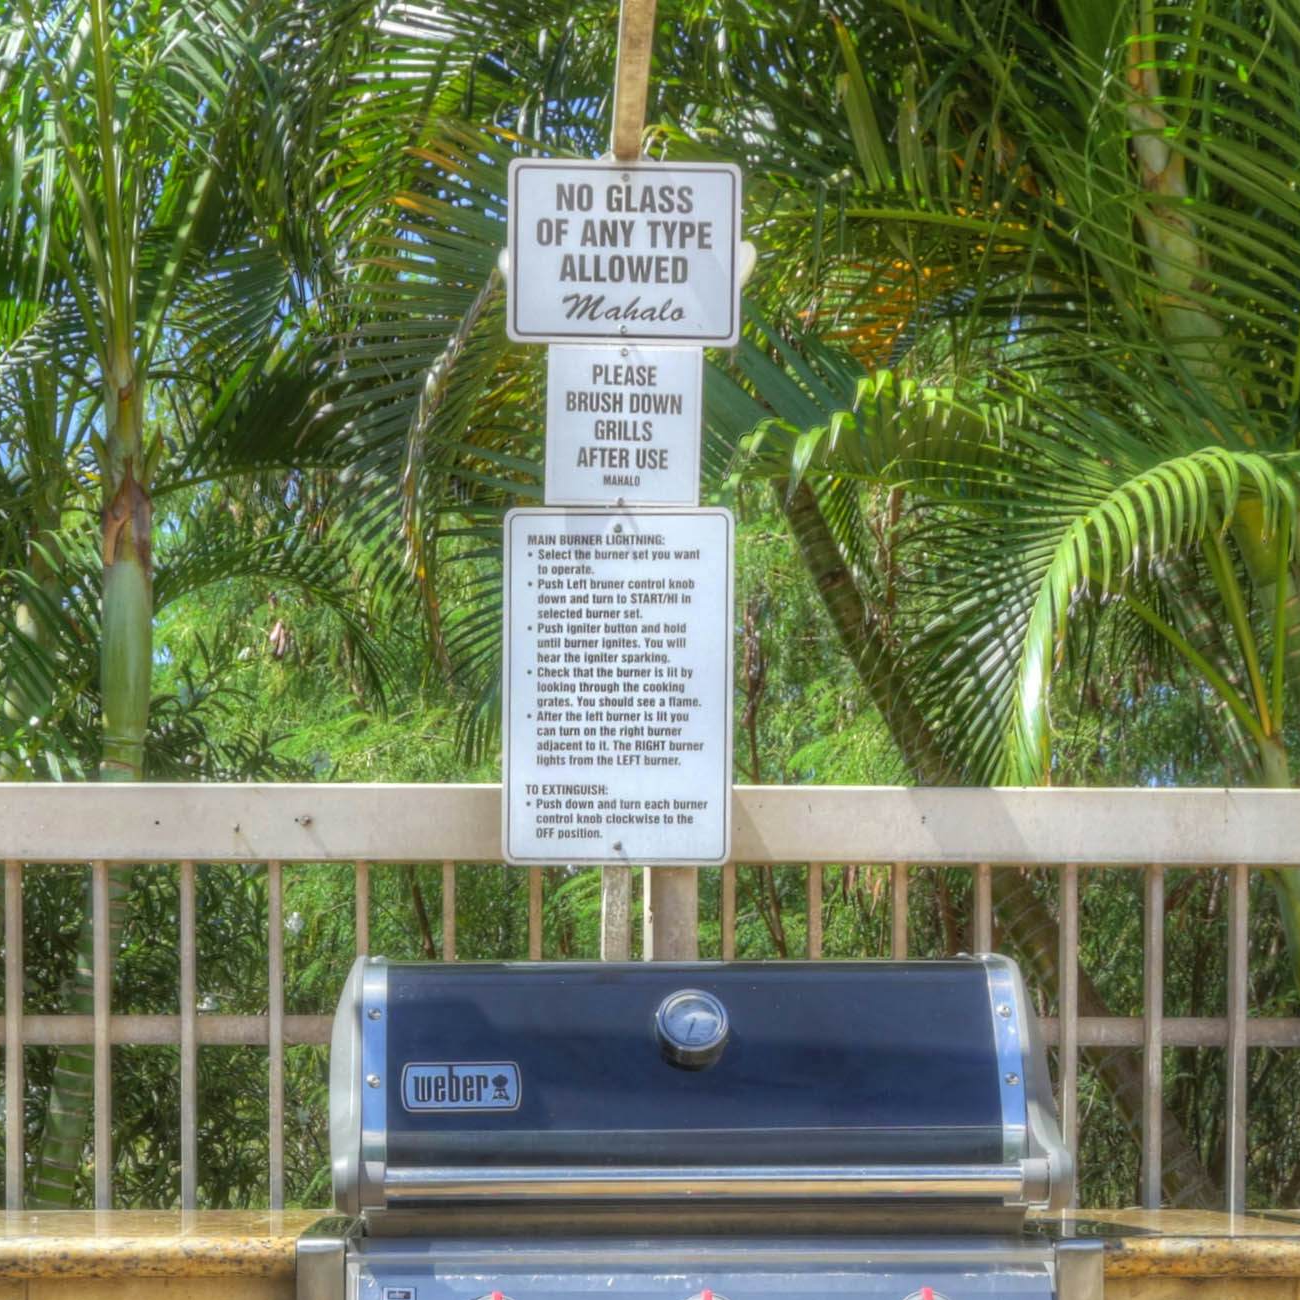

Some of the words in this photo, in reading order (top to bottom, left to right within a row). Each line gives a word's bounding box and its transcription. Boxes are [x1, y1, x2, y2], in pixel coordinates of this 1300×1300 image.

[556, 184, 593, 211] NO
[607, 185, 693, 213] GLASS
[537, 219, 568, 246] OF
[581, 220, 634, 248] ANY
[647, 221, 712, 249] TYPE
[560, 254, 688, 283] ALLOWED
[562, 294, 687, 321] Mahalo
[593, 365, 657, 386] PLEASE
[566, 392, 623, 413] BRUSH
[630, 393, 682, 414] DOWN
[595, 420, 652, 441] GRILLS
[577, 447, 629, 468] AFTER
[636, 448, 668, 469] USE
[604, 476, 640, 486] MAHALO
[528, 535, 556, 545] MAIN
[560, 535, 602, 545] BURNER
[606, 535, 665, 545] LIGHTNING:
[538, 550, 571, 560] Select
[575, 550, 591, 560] the
[595, 550, 629, 560] burner
[633, 551, 648, 560] set
[652, 552, 670, 562] you
[674, 550, 700, 560] want
[538, 565, 548, 574] to
[551, 565, 594, 576] operate.
[538, 579, 563, 589] Push
[567, 579, 586, 589] Left
[590, 579, 624, 589] bruner
[628, 579, 665, 589] control
[669, 579, 694, 589] knob
[538, 594, 566, 604] down
[570, 594, 589, 604] and
[593, 595, 614, 604] turn
[617, 595, 627, 604] to
[630, 594, 677, 604] START/HI
[682, 594, 691, 604] in
[538, 609, 582, 619] selected
[586, 609, 620, 619] burner
[624, 610, 643, 619] set.
[538, 624, 563, 633] Push
[567, 624, 601, 635] igniter
[604, 624, 638, 633] button
[641, 624, 660, 633] and
[664, 624, 686, 633] hold
[537, 638, 560, 648] until
[564, 638, 598, 648] burner
[602, 638, 641, 650] ignites.
[645, 638, 663, 648] You
[667, 638, 686, 648] will
[537, 653, 560, 663] hear
[564, 653, 580, 663] the
[584, 653, 618, 665] igniter
[622, 653, 670, 665] sparking.
[537, 668, 570, 678] Check
[573, 668, 594, 678] that
[597, 668, 613, 678] the
[617, 668, 651, 678] burner
[655, 668, 664, 678] is
[667, 668, 678, 678] lit
[681, 668, 693, 680] by
[537, 682, 576, 694] looking
[579, 682, 619, 694] through
[623, 683, 639, 692] the
[643, 682, 684, 694] cooking
[537, 698, 573, 709] grates.
[577, 697, 595, 707] You
[599, 697, 633, 707] should
[637, 699, 656, 707] see
[660, 699, 666, 707] a
[669, 697, 702, 707] flame.
[537, 712, 562, 721] After
[566, 712, 582, 721] the
[586, 712, 603, 721] left
[606, 712, 640, 721] burner
[644, 712, 653, 721] is
[657, 712, 667, 721] lit
[671, 714, 689, 723] you
[537, 728, 556, 736] can
[559, 727, 580, 736] turn
[583, 728, 596, 736] on
[600, 727, 616, 736] the
[620, 727, 644, 738] right
[648, 727, 682, 736] burner
[537, 741, 582, 753] adjacent
[586, 742, 595, 751] to
[599, 741, 609, 751] it.
[613, 741, 631, 751] The
[635, 741, 665, 751] RIGHT
[669, 741, 704, 751] burner
[537, 756, 565, 767] lights
[569, 756, 593, 766] from
[597, 756, 613, 766] the
[617, 756, 640, 766] LEFT
[644, 756, 681, 766] burner.
[526, 785, 538, 795] TO
[542, 785, 608, 795] EXTINGUISH:
[536, 799, 562, 809] Push
[565, 800, 594, 809] down
[597, 800, 616, 809] and
[620, 800, 641, 809] turn
[644, 800, 670, 809] each
[673, 800, 708, 809] burner
[536, 814, 573, 824] control
[577, 814, 602, 824] knob
[606, 814, 660, 824] clockwise
[663, 815, 673, 824] to
[677, 814, 693, 824] the
[536, 829, 555, 838] OFF
[558, 829, 603, 840] position.
[413, 1065, 488, 1102] weber
